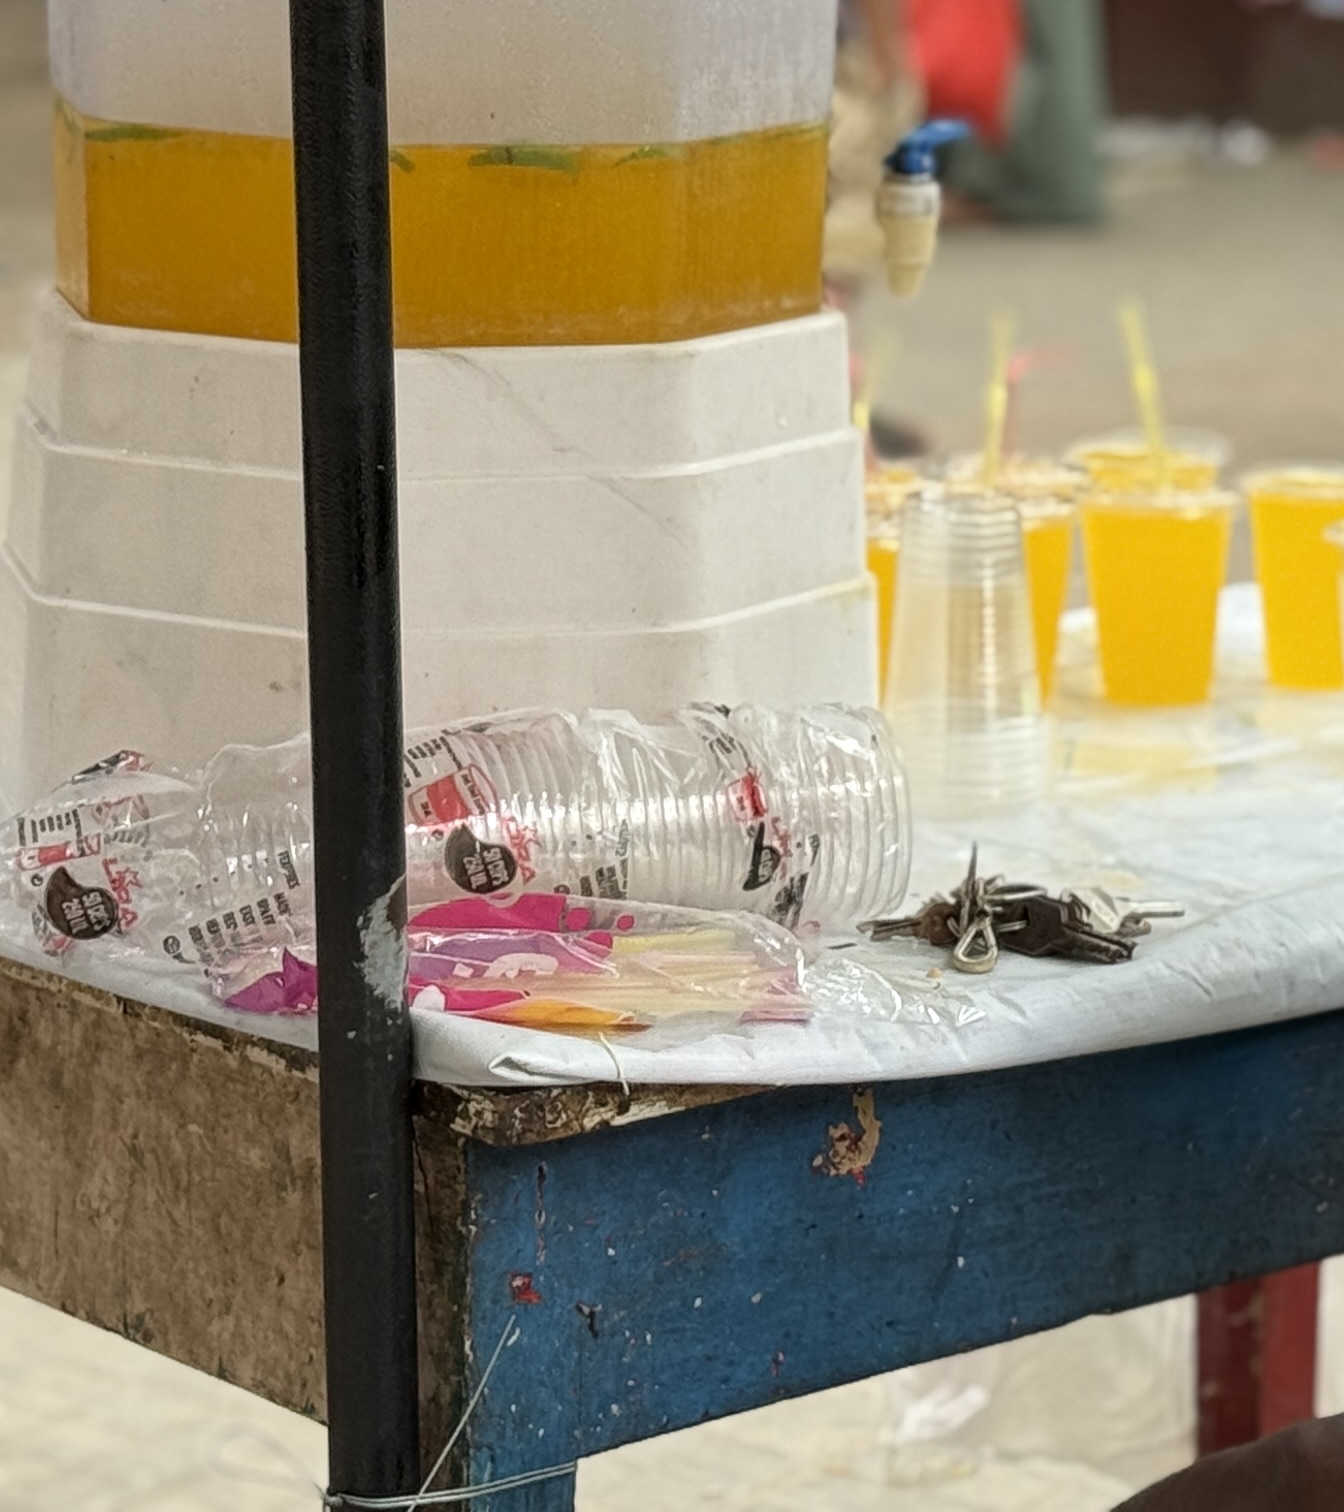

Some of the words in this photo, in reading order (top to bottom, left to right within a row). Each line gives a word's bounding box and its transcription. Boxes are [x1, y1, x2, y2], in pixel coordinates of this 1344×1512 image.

[463, 853, 484, 876] 250
[483, 847, 503, 863] 50
[487, 859, 509, 886] CUPS
[62, 898, 85, 920] 250
[82, 891, 103, 907] 50
